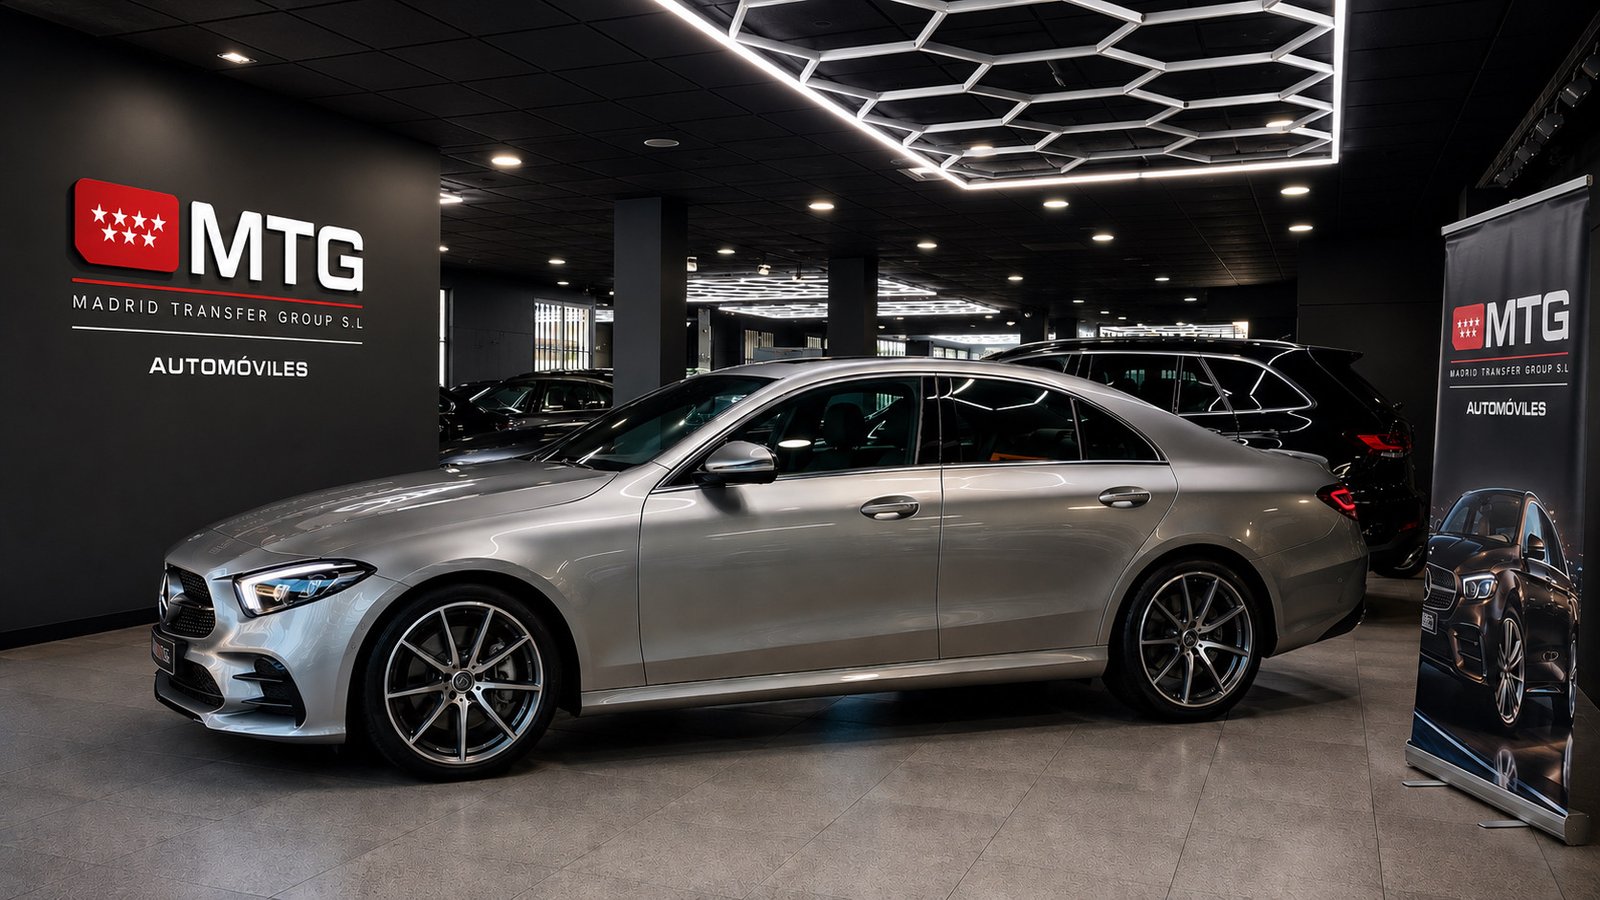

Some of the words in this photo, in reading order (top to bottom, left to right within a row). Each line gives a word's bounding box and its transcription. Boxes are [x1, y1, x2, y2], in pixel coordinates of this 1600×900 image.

[191, 200, 363, 292] MTG
[72, 294, 159, 314] MADRID
[171, 302, 267, 322] TRANSFER
[278, 311, 333, 327] GROUP
[342, 315, 363, 329] S.L
[1485, 289, 1570, 348] MTG
[149, 355, 308, 377] AUTOMÓVILES
[1450, 368, 1478, 378] MADRID
[1481, 365, 1521, 376] TRANSFER
[1525, 363, 1553, 375] GROUP
[1556, 363, 1569, 373] S.L
[1466, 398, 1547, 416] AUTOMÓVILES
